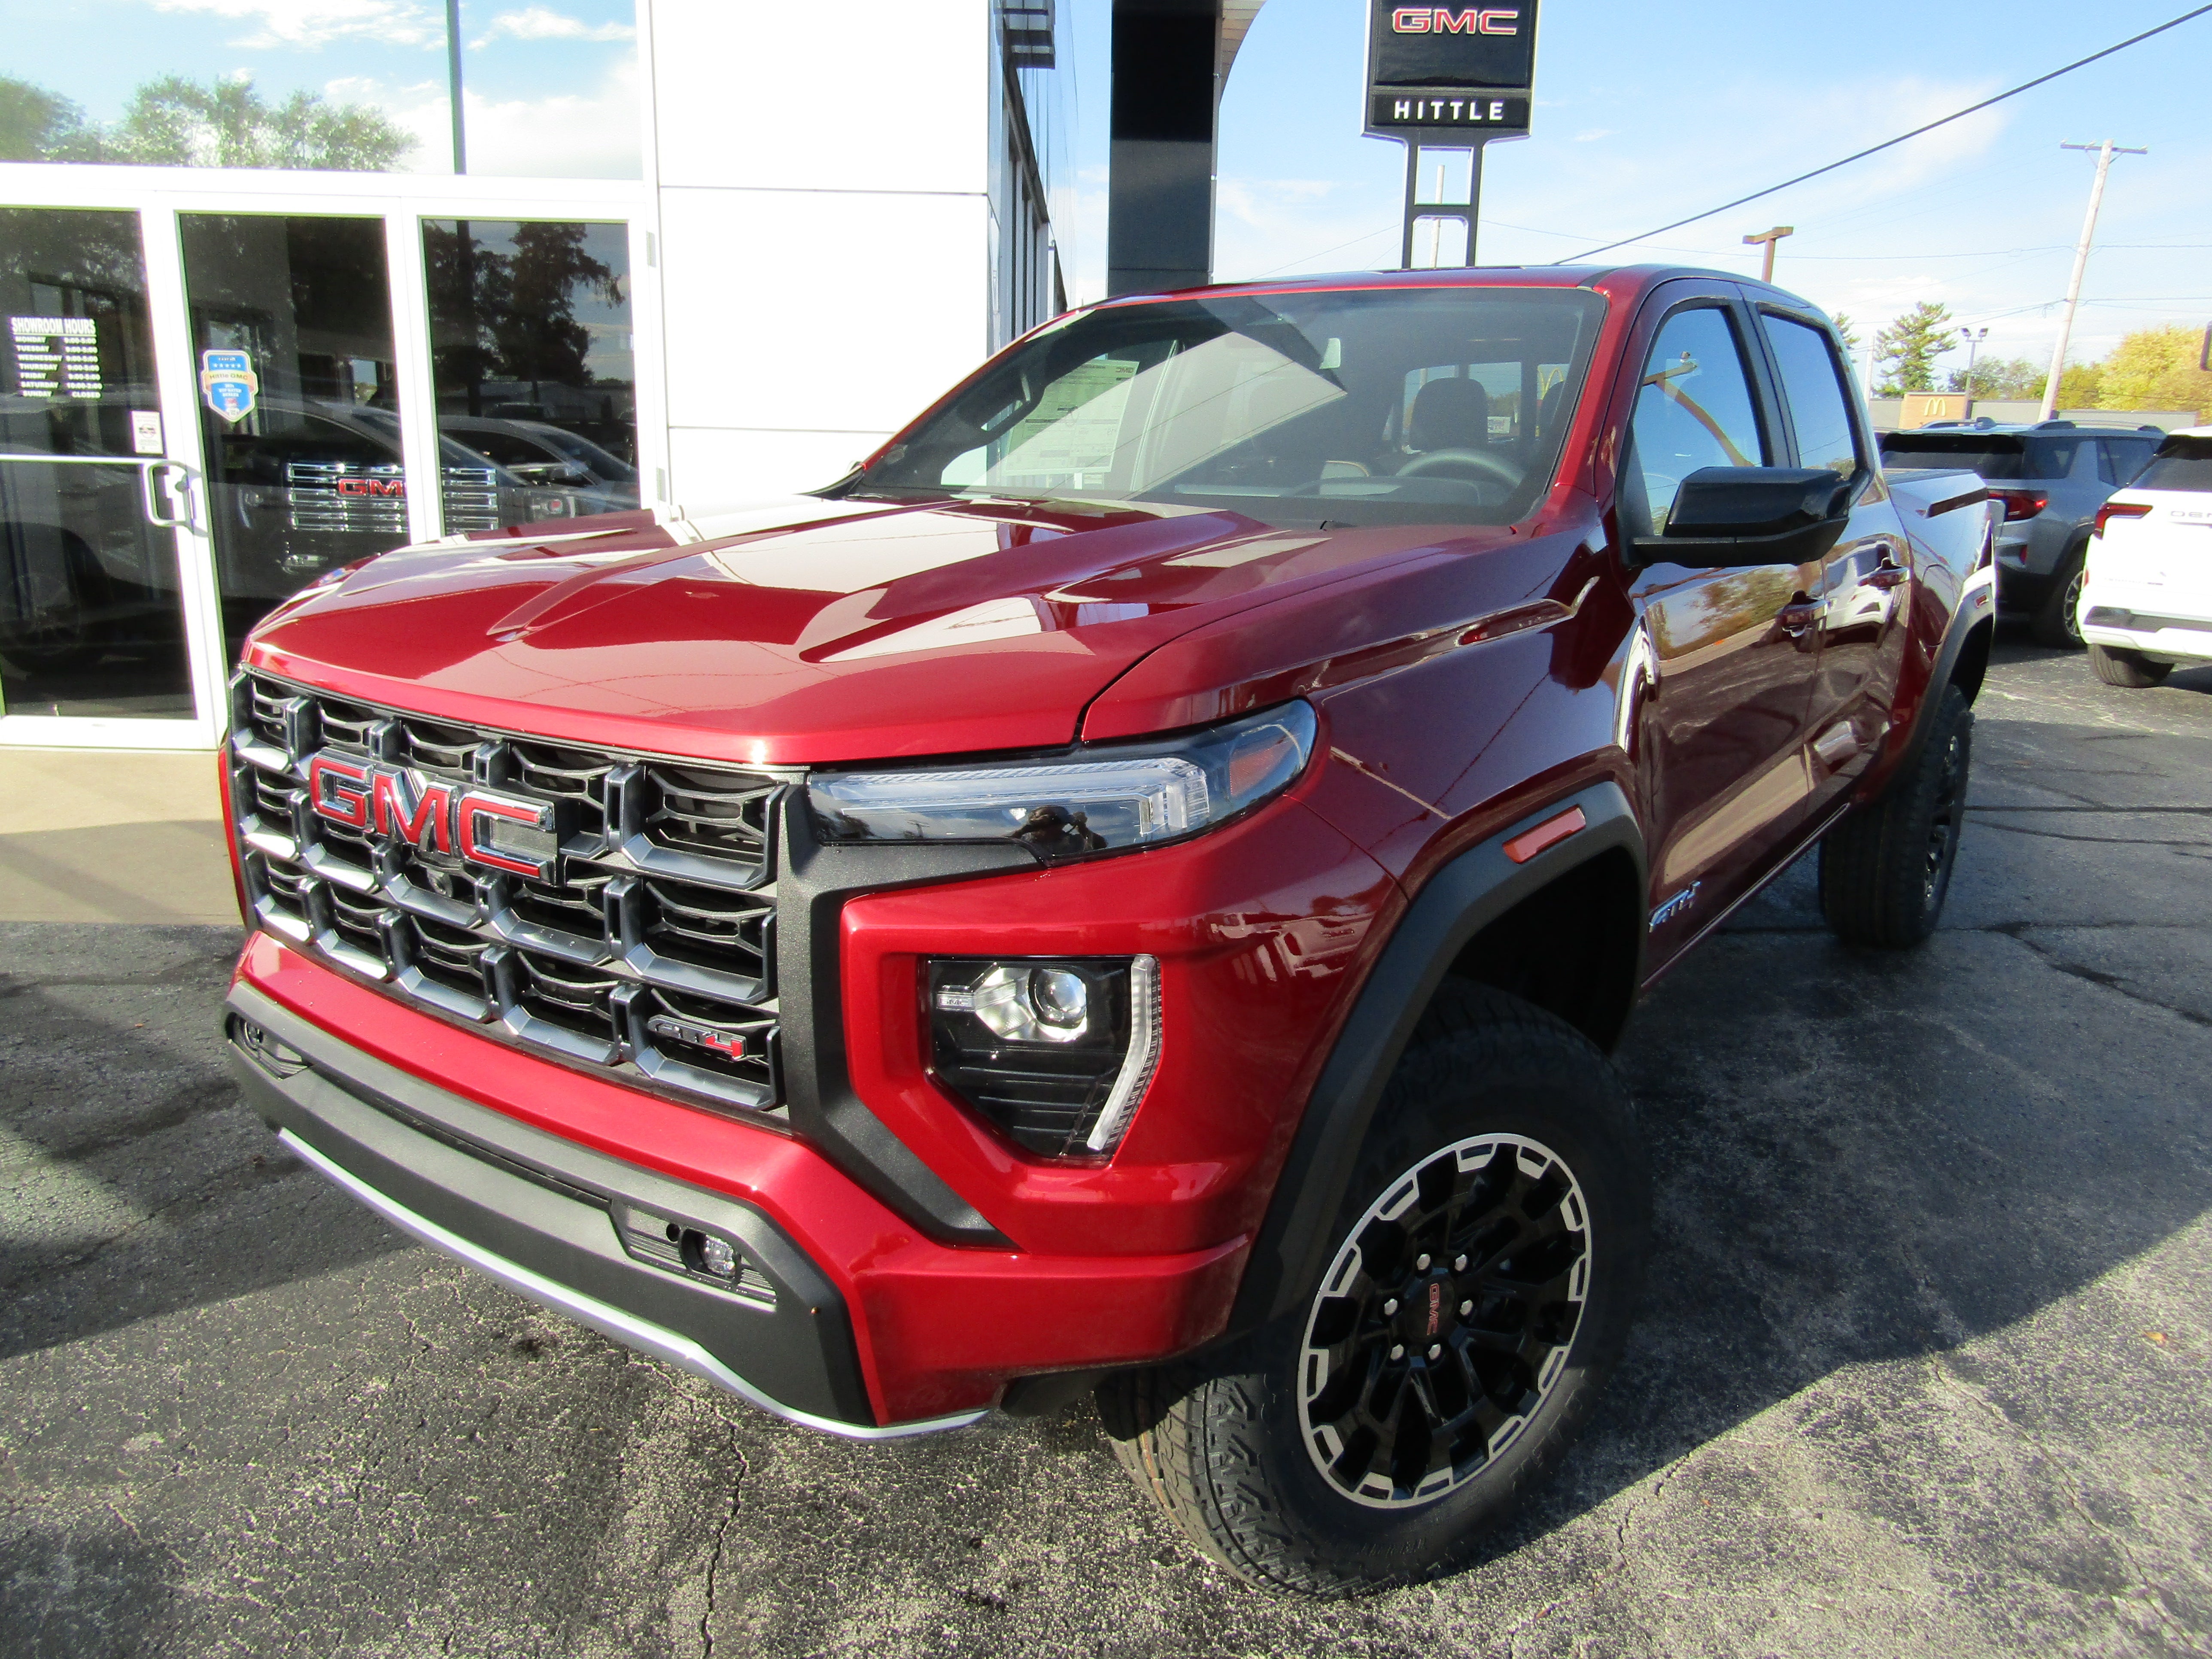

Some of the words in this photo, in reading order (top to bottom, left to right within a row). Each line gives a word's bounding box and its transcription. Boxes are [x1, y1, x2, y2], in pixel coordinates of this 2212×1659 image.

[1392, 8, 1519, 36] GMC
[1393, 100, 1504, 121] HITTLE
[12, 317, 63, 333] SHOWROOM
[64, 319, 96, 334] HOURS
[338, 478, 404, 497] GM
[309, 748, 557, 886] GMC
[939, 996, 970, 1006] GMC
[1426, 1283, 1440, 1336] GMC
